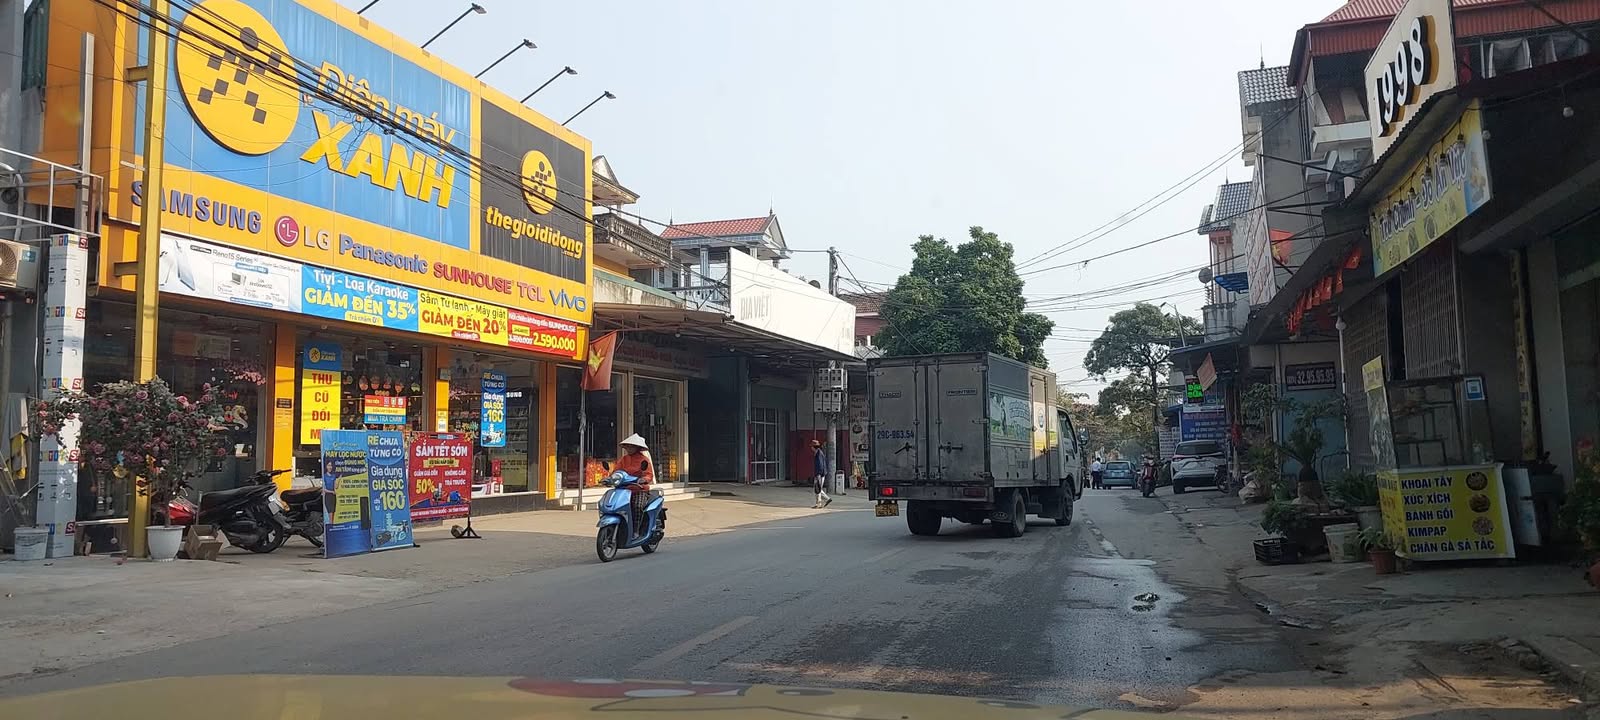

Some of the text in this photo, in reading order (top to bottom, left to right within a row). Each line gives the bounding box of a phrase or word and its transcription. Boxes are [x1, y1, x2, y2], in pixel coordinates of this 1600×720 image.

[1376, 16, 1432, 138] 1998
[299, 110, 456, 209] XANH
[303, 226, 331, 255] LG
[485, 205, 583, 260] thegioididong
[338, 232, 438, 275] Panasonic
[432, 261, 512, 295] SUNHOUSE
[345, 276, 364, 292] Loa
[366, 280, 409, 300] Karaoke
[516, 280, 545, 302] TCL
[304, 285, 416, 320] GIẢM ĐẾN 35%
[548, 288, 586, 312] vivo
[422, 307, 506, 335] GIẢM ĐẾN 20%
[532, 331, 576, 352] 2.590.000
[312, 373, 333, 385] THU
[315, 391, 329, 403] CŨ
[312, 406, 330, 421] ĐỔI
[368, 433, 399, 446] RẺ CHƯA
[416, 439, 468, 457] SẮM TẾT SỚM
[392, 447, 402, 457] CÓ
[371, 465, 403, 479] Gia dụng
[372, 476, 387, 491] GIÁ
[388, 475, 405, 490] SỐC
[416, 478, 435, 494] 50%
[1401, 476, 1452, 490] KHOAI TÂY
[1427, 492, 1451, 504] XÍCH
[1408, 526, 1447, 537] KIMPAP
[1410, 541, 1438, 553] CHÂN
[1440, 538, 1455, 552] GÀ
